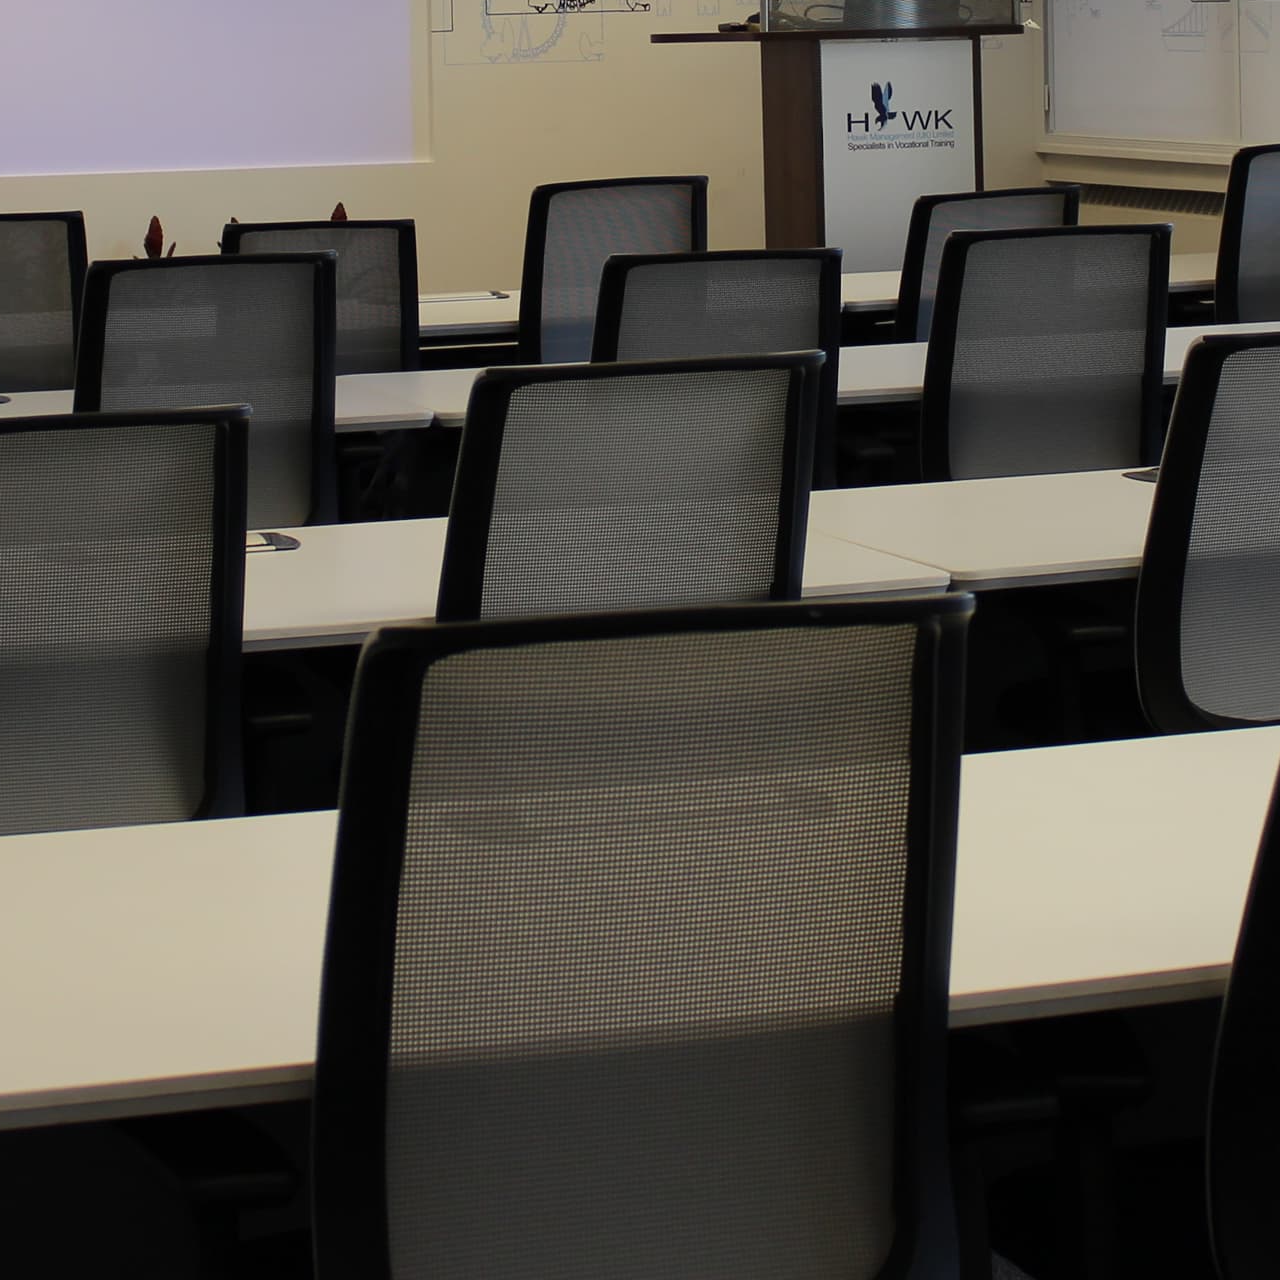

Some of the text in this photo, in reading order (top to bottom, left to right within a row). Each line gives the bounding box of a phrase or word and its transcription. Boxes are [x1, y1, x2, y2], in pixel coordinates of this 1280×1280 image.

[847, 109, 953, 132] HWK
[847, 138, 955, 151] Specialists in Vocational Training
